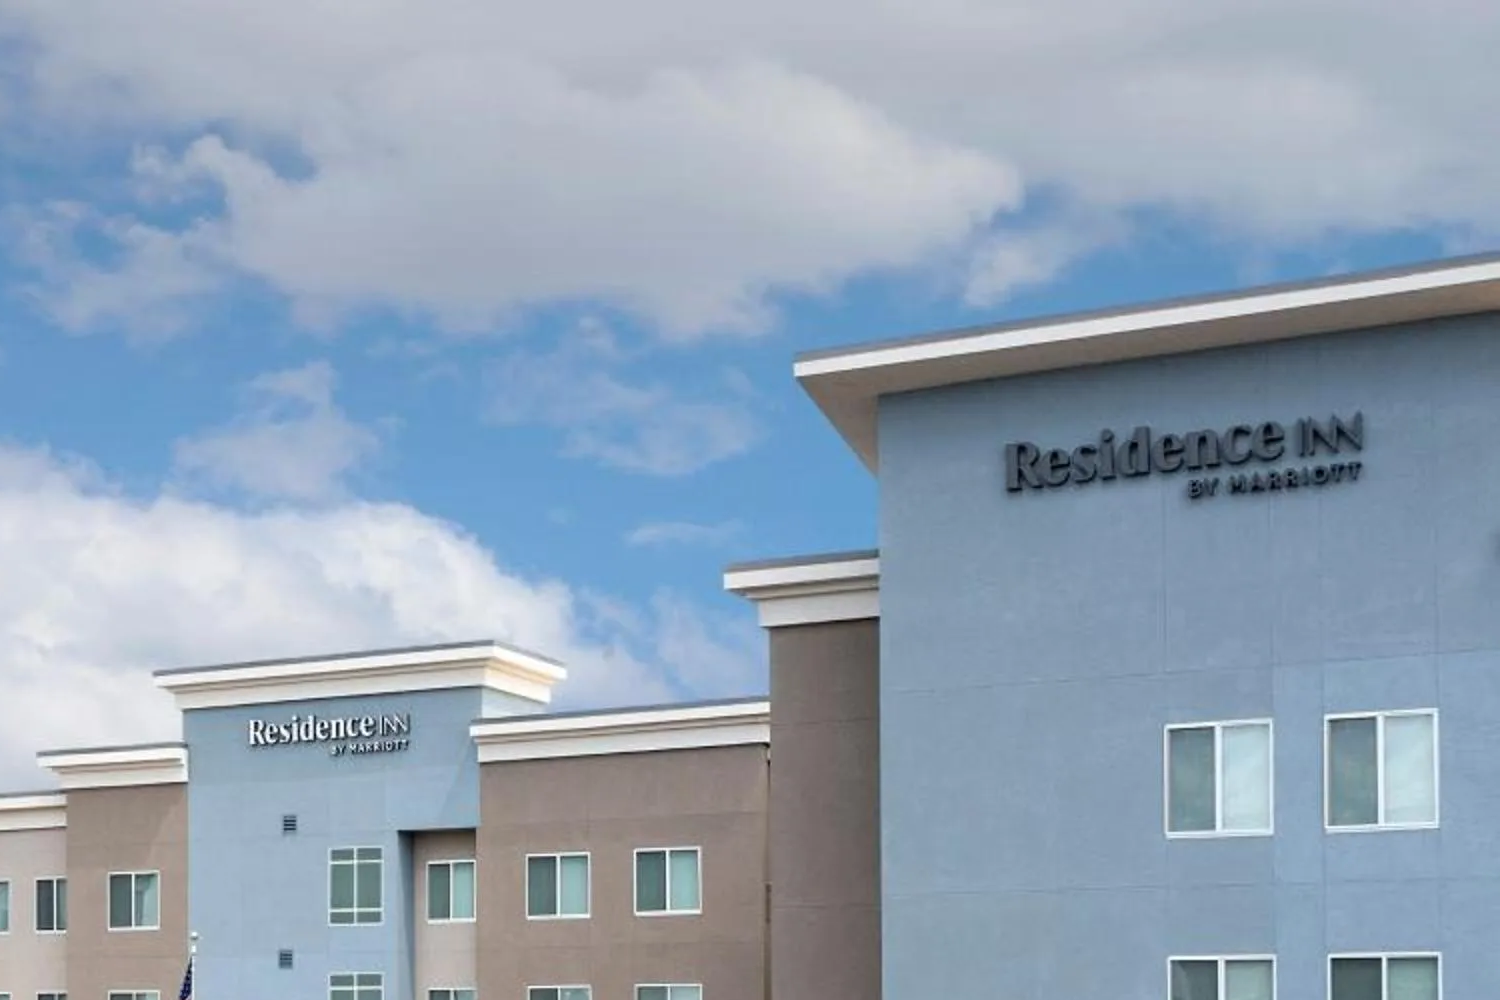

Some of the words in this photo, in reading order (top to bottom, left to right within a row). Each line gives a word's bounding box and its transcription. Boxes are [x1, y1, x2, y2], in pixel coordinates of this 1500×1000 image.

[1005, 419, 1286, 493] Residence
[1297, 410, 1364, 458] INN
[1188, 477, 1218, 500] BY
[1230, 461, 1364, 497] MARRIOTT
[249, 714, 375, 747] Residence
[379, 712, 411, 736] INN
[350, 739, 410, 755] MARRIOTT
